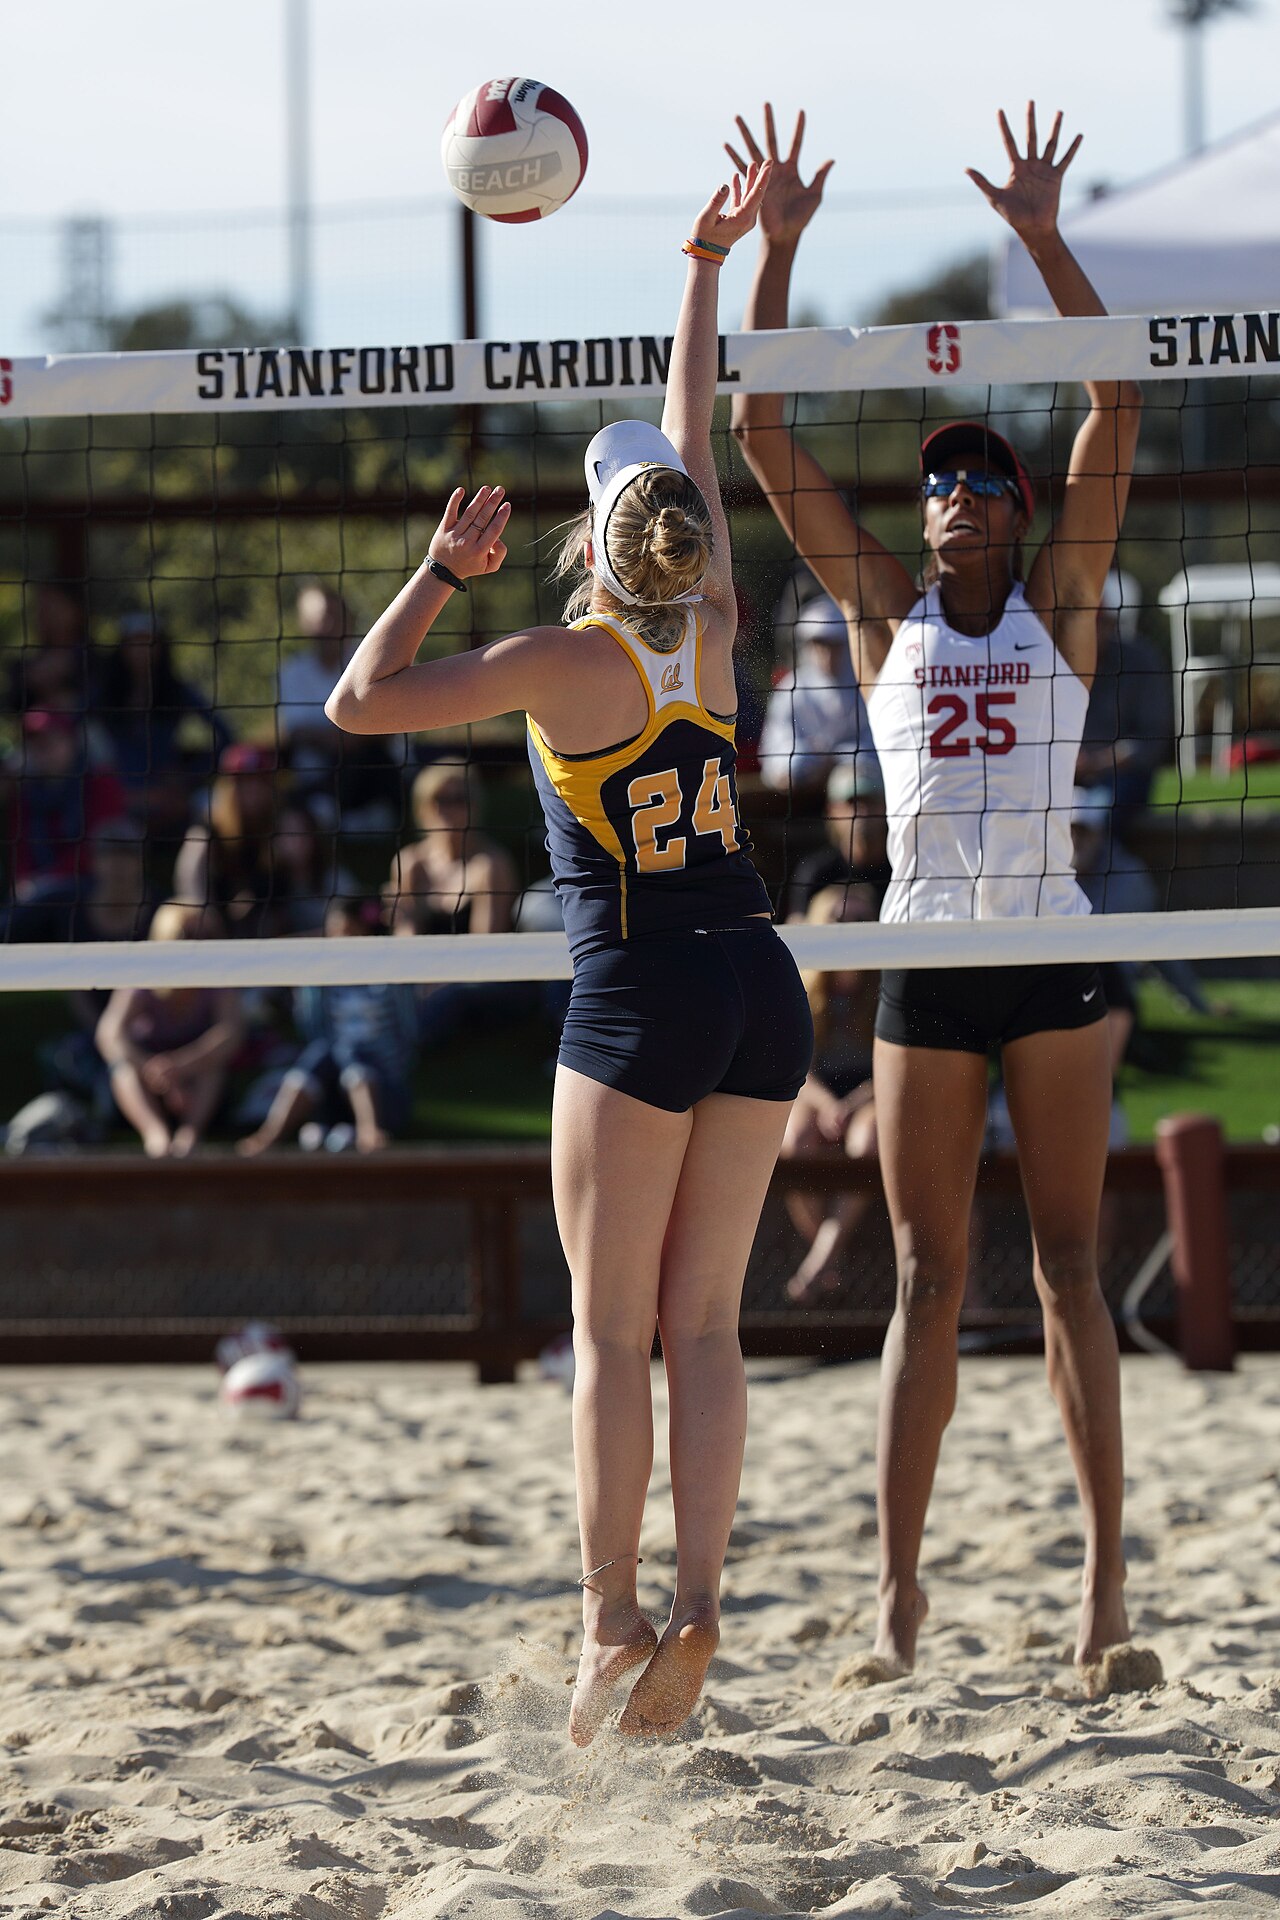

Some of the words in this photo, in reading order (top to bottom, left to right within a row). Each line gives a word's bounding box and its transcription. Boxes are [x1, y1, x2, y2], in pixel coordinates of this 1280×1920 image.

[457, 158, 541, 191] BEACH
[197, 343, 455, 399] STANFORD
[484, 335, 740, 390] CARDINL
[1149, 313, 1280, 367] STAN
[660, 663, 684, 695] Cal
[914, 662, 1030, 689] STANFORD
[927, 692, 1017, 758] 25
[627, 757, 740, 873] 24
